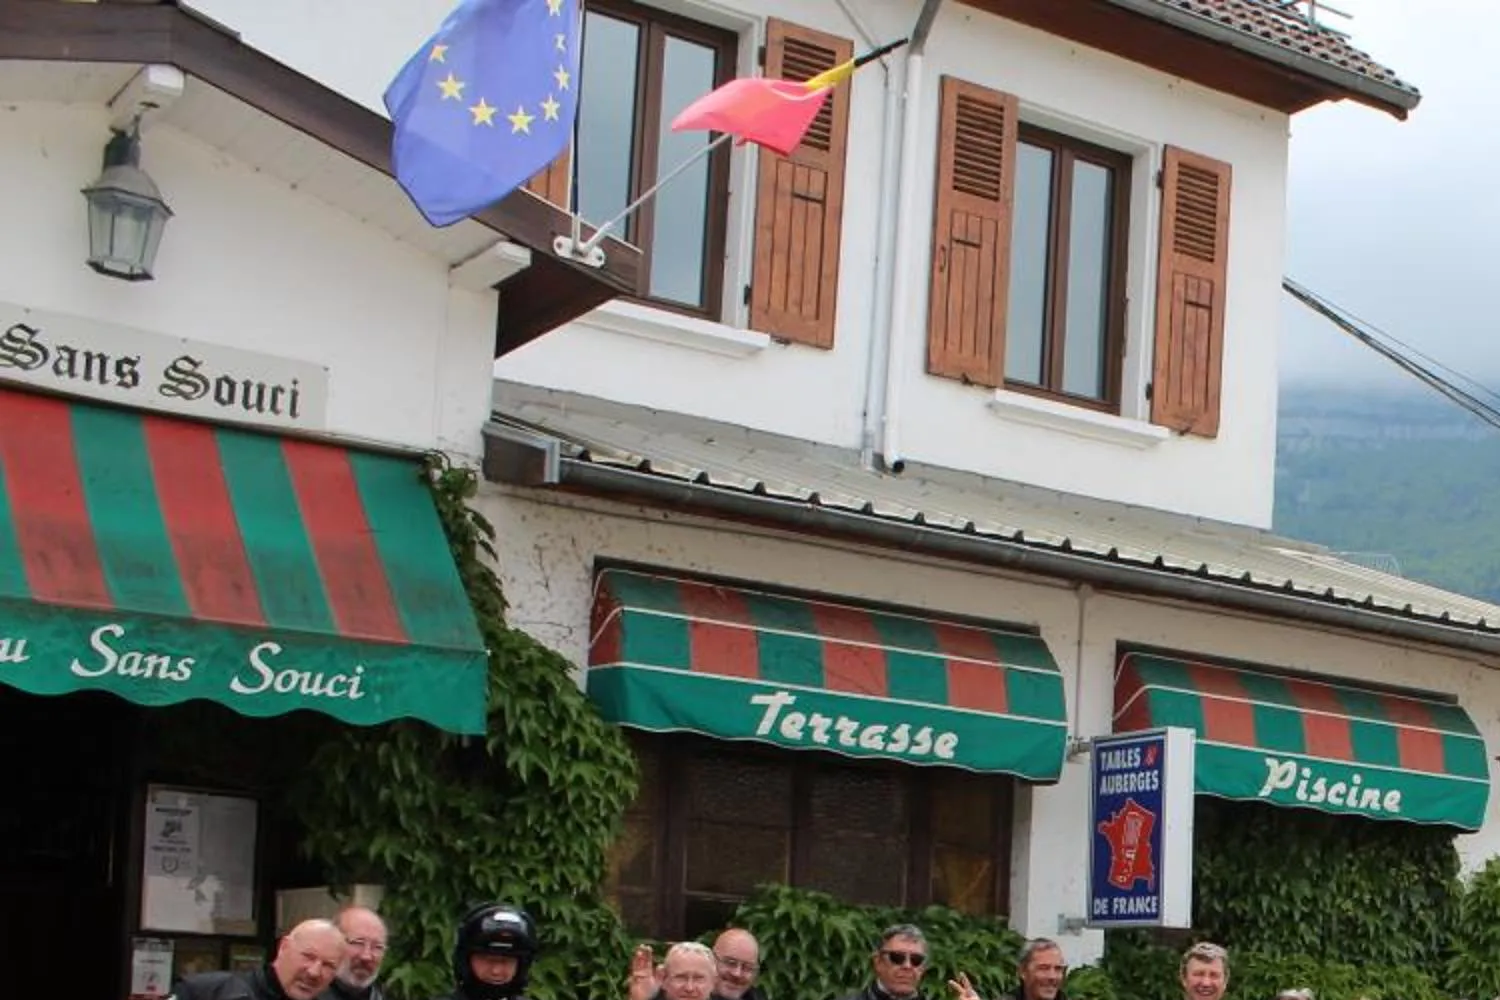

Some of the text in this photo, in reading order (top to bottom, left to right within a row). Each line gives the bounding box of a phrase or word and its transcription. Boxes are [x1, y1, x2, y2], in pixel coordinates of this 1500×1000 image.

[0, 323, 301, 419] Sans Souci
[70, 623, 196, 682] Sans
[230, 641, 366, 699] Souci
[750, 691, 960, 760] Terrasse
[1100, 769, 1159, 795] AUBERGES
[1101, 747, 1142, 771] TABLES
[1258, 757, 1402, 813] Piscine
[1093, 895, 1159, 915] DE FRANCE
